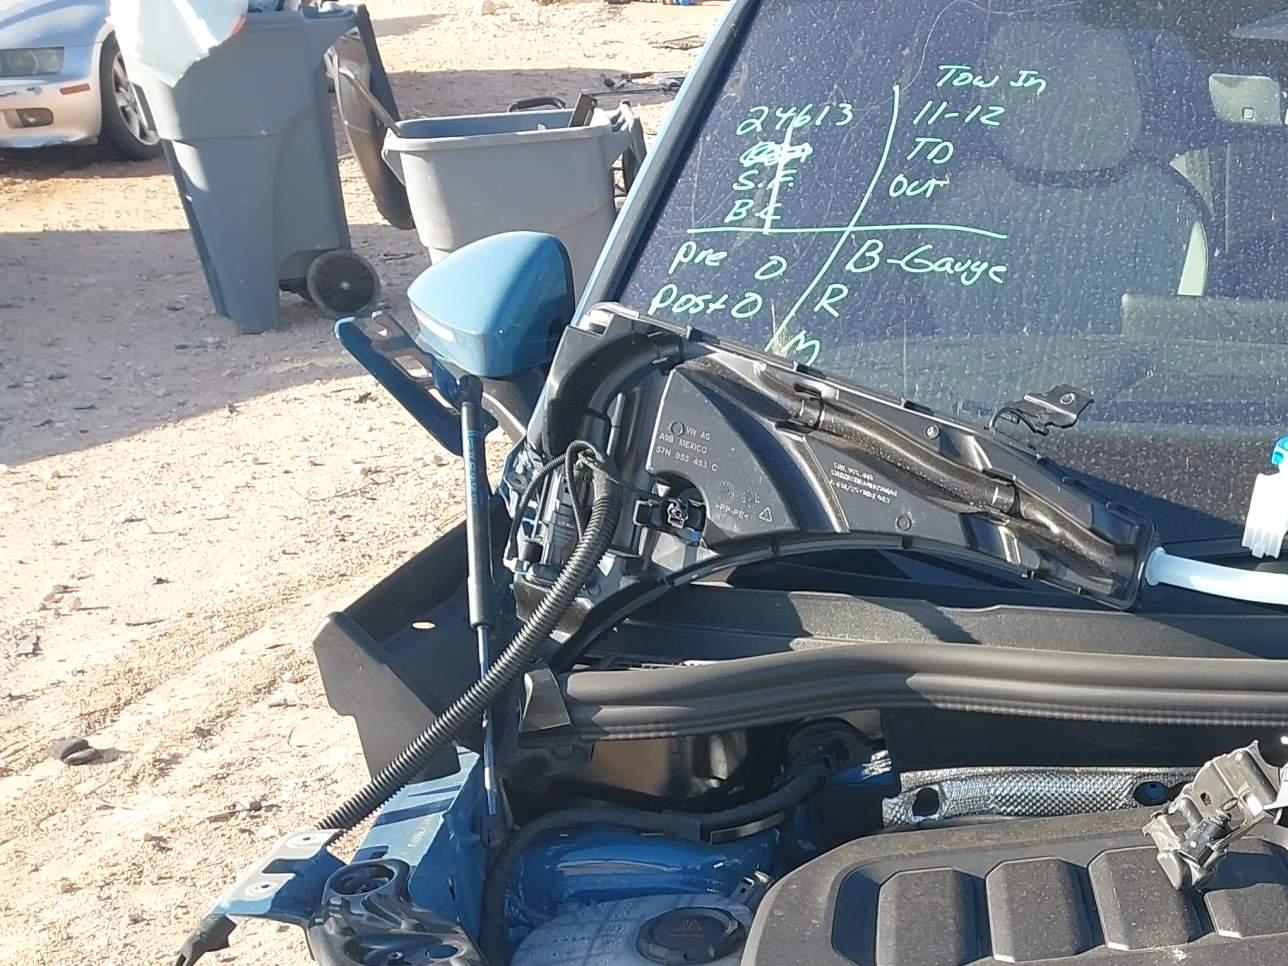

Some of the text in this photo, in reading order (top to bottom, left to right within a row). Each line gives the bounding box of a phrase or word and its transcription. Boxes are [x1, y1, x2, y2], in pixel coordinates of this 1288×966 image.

[936, 64, 1047, 96] Tow In
[912, 100, 1005, 125] 11-12
[679, 439, 707, 454] MEXICO
